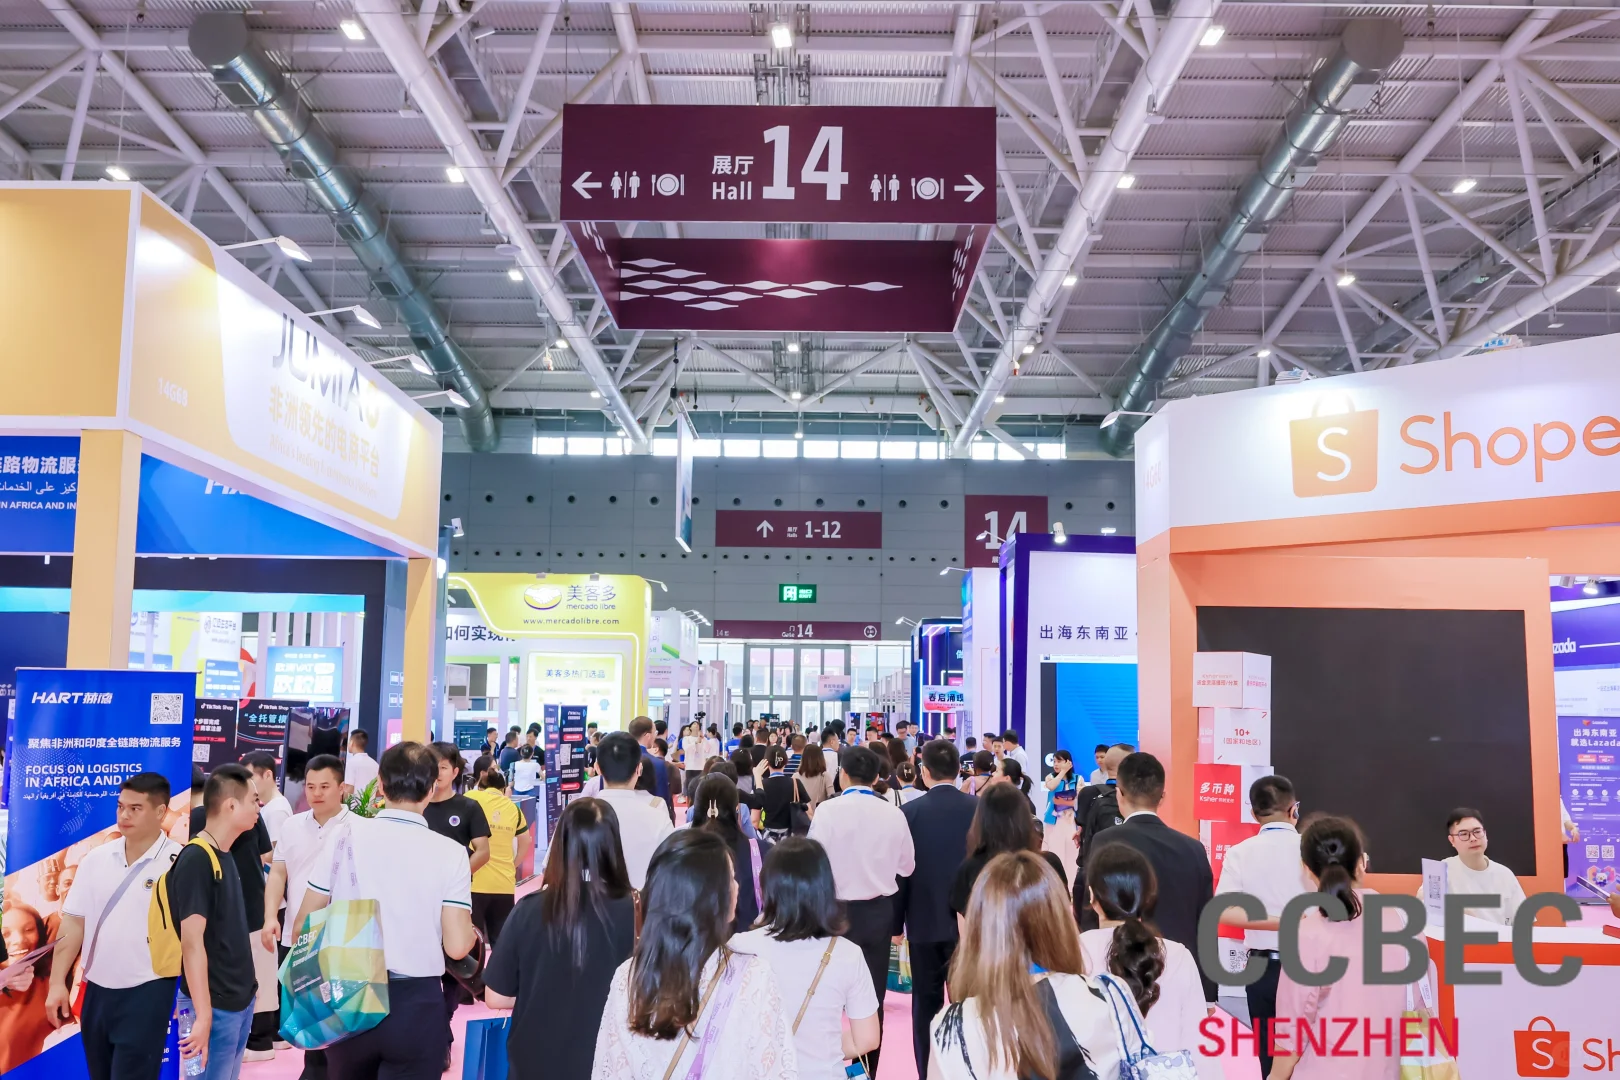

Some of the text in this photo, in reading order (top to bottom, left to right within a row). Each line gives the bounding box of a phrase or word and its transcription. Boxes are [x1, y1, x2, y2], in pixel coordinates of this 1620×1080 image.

[711, 155, 755, 176] 展厅
[761, 124, 850, 201] 14
[711, 180, 753, 201] Hall
[0, 455, 80, 475] 路物流服
[9, 501, 44, 510] AFRICA
[44, 501, 65, 510] AND
[805, 520, 842, 539] 1-12
[566, 585, 617, 602] 美客多
[566, 602, 617, 610] mercado libre
[522, 617, 620, 626] www.mercadolibre.com
[781, 631, 796, 639] Gate
[797, 623, 814, 639] 14
[1039, 624, 1129, 641] 出海东南亚
[1552, 637, 1577, 655] zada
[31, 691, 84, 704] HART
[1234, 728, 1250, 737] 10+
[1573, 728, 1618, 738] 出海东南亚
[27, 736, 182, 749] 聚焦非洲和印度全链路物流服务
[25, 763, 143, 775] FOCUS ON LOGISTICS
[25, 777, 40, 788] IN
[43, 775, 91, 787] AFRICA
[93, 774, 123, 786] AND
[1199, 781, 1235, 796] 多币种
[293, 929, 318, 949] CBEC
[1582, 1037, 1620, 1072] Sh
